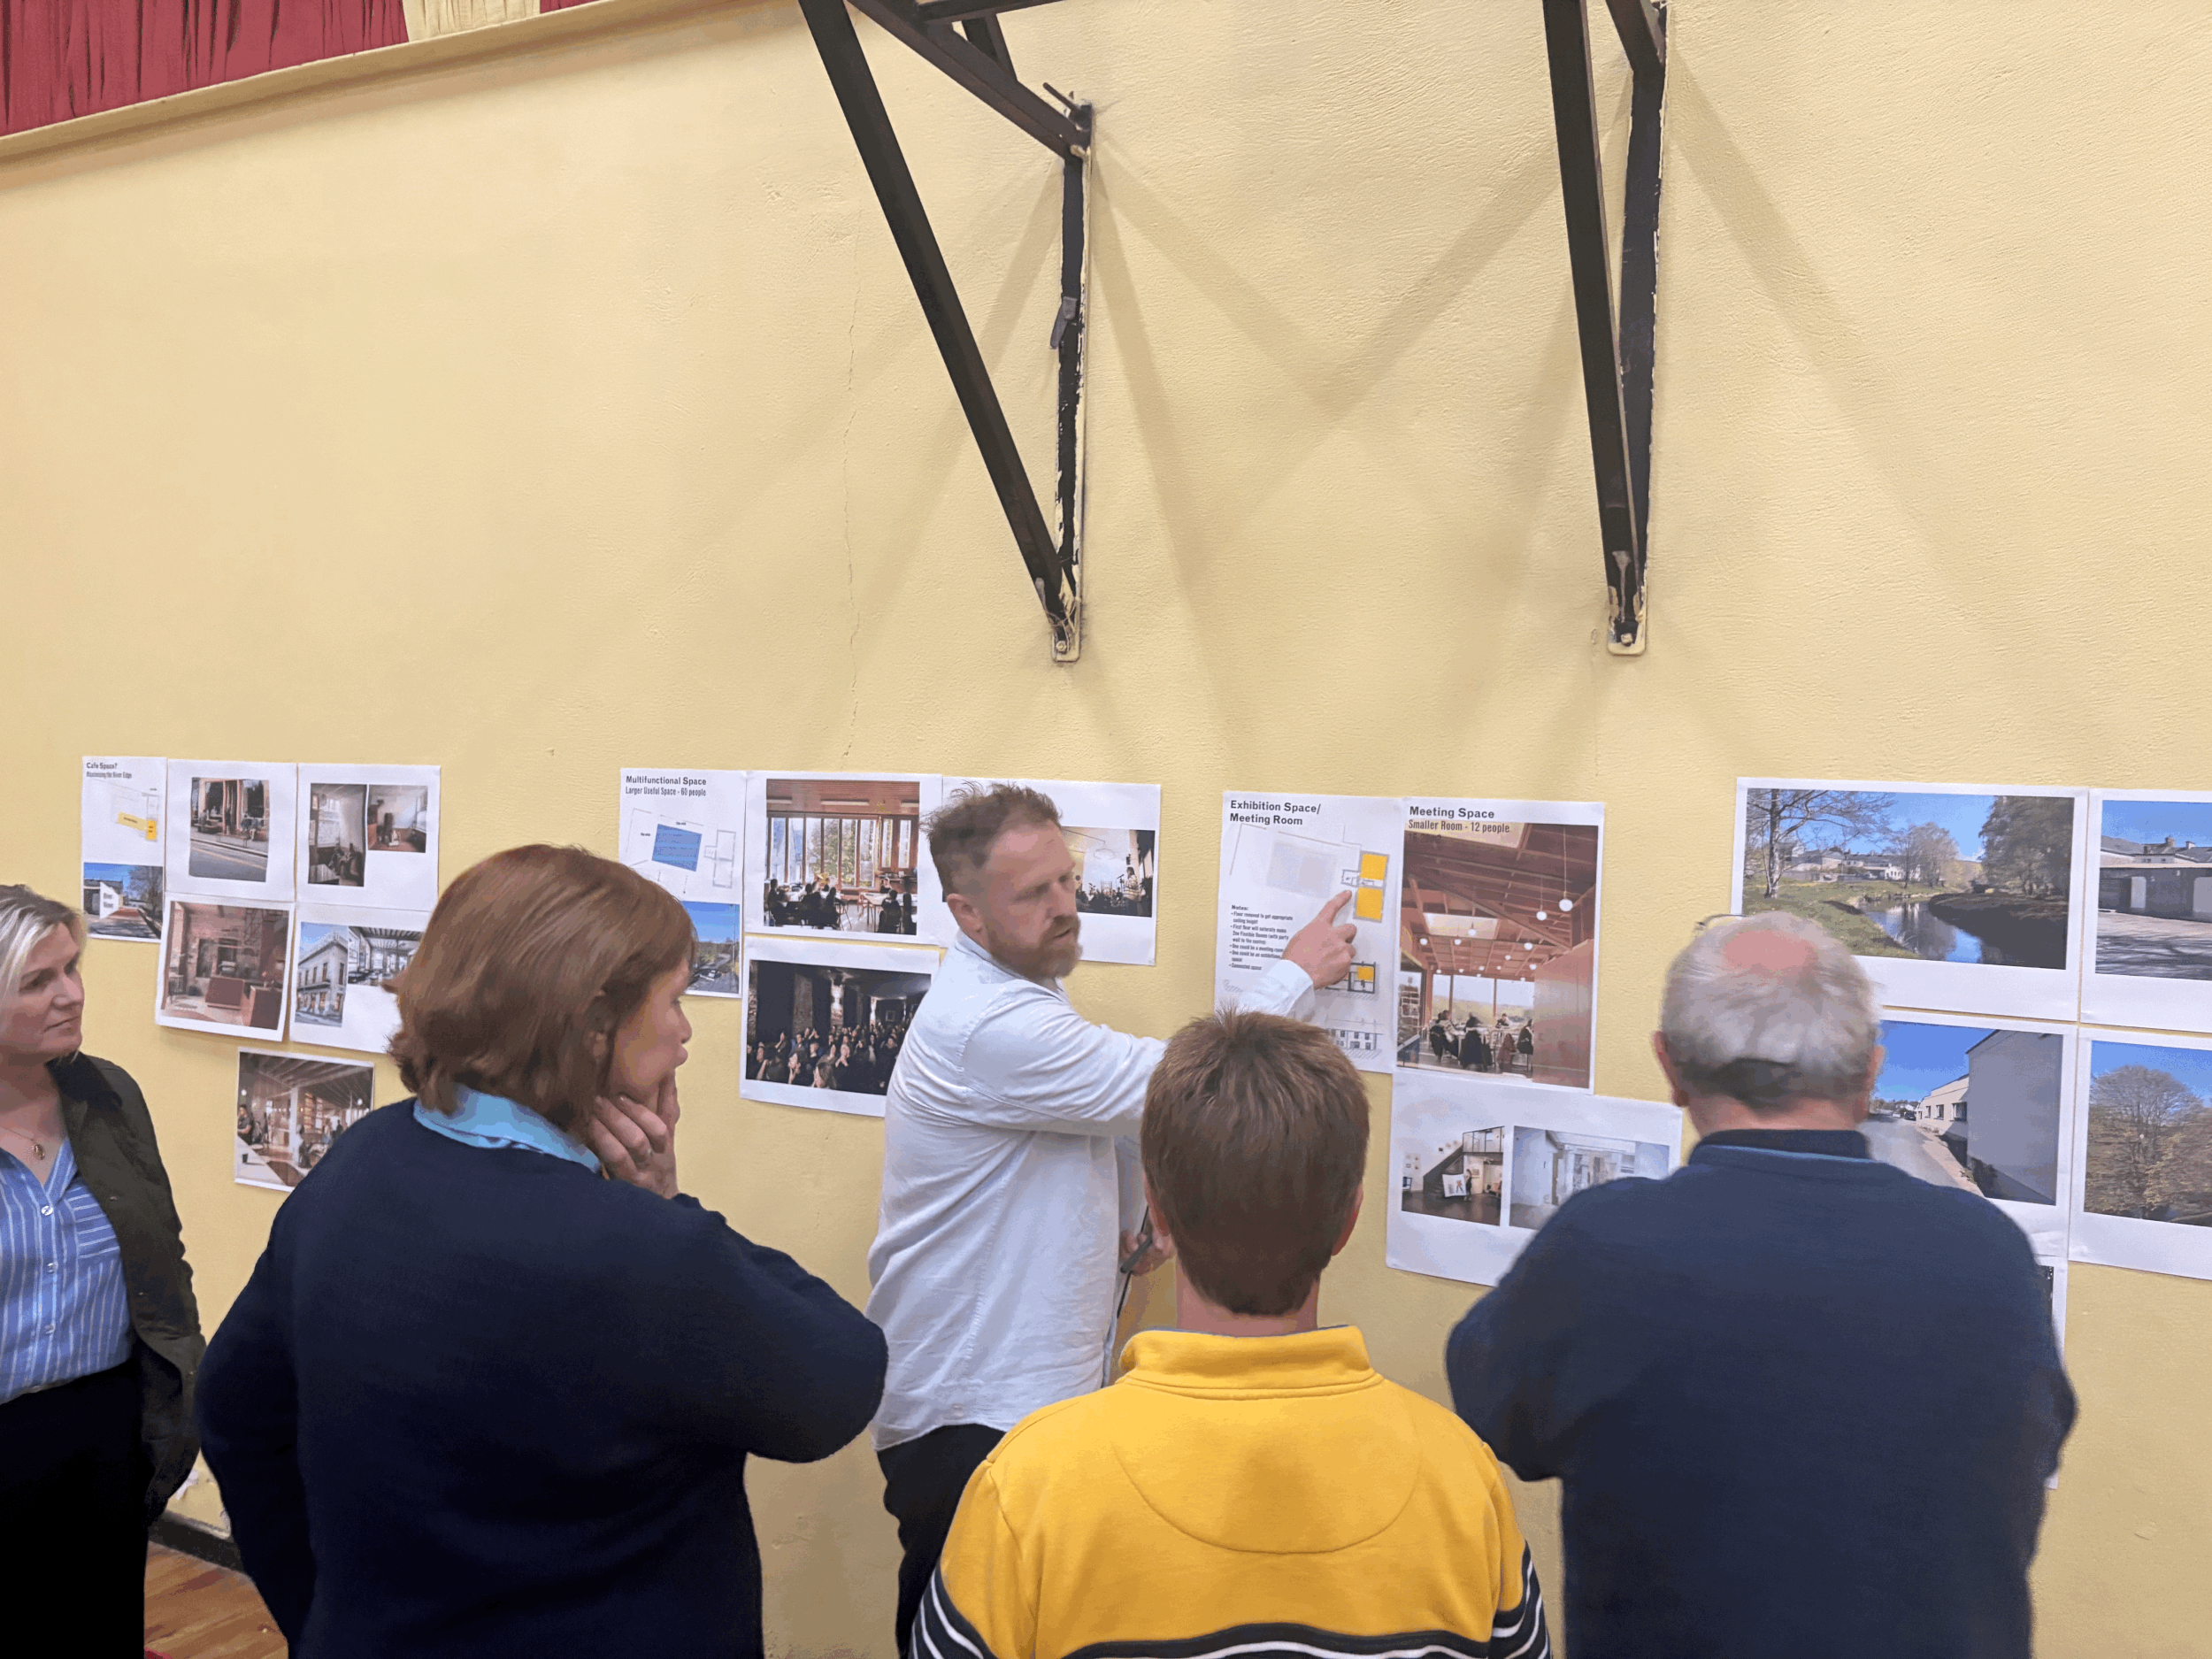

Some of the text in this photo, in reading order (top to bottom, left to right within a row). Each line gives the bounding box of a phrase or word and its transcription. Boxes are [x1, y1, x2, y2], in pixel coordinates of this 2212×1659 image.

[626, 775, 707, 787] Multifunctional Space
[626, 786, 642, 795] Larger
[661, 787, 676, 796] Space
[680, 787, 687, 796] 60
[688, 787, 707, 797] people
[1230, 800, 1321, 815] Exhibition Space/
[1409, 805, 1495, 820] Meeting Space
[1230, 812, 1303, 826] Meeting Room
[1408, 818, 1439, 831] Smaller
[1440, 820, 1463, 831] Room
[1471, 822, 1479, 832] 12
[1481, 822, 1509, 833] people
